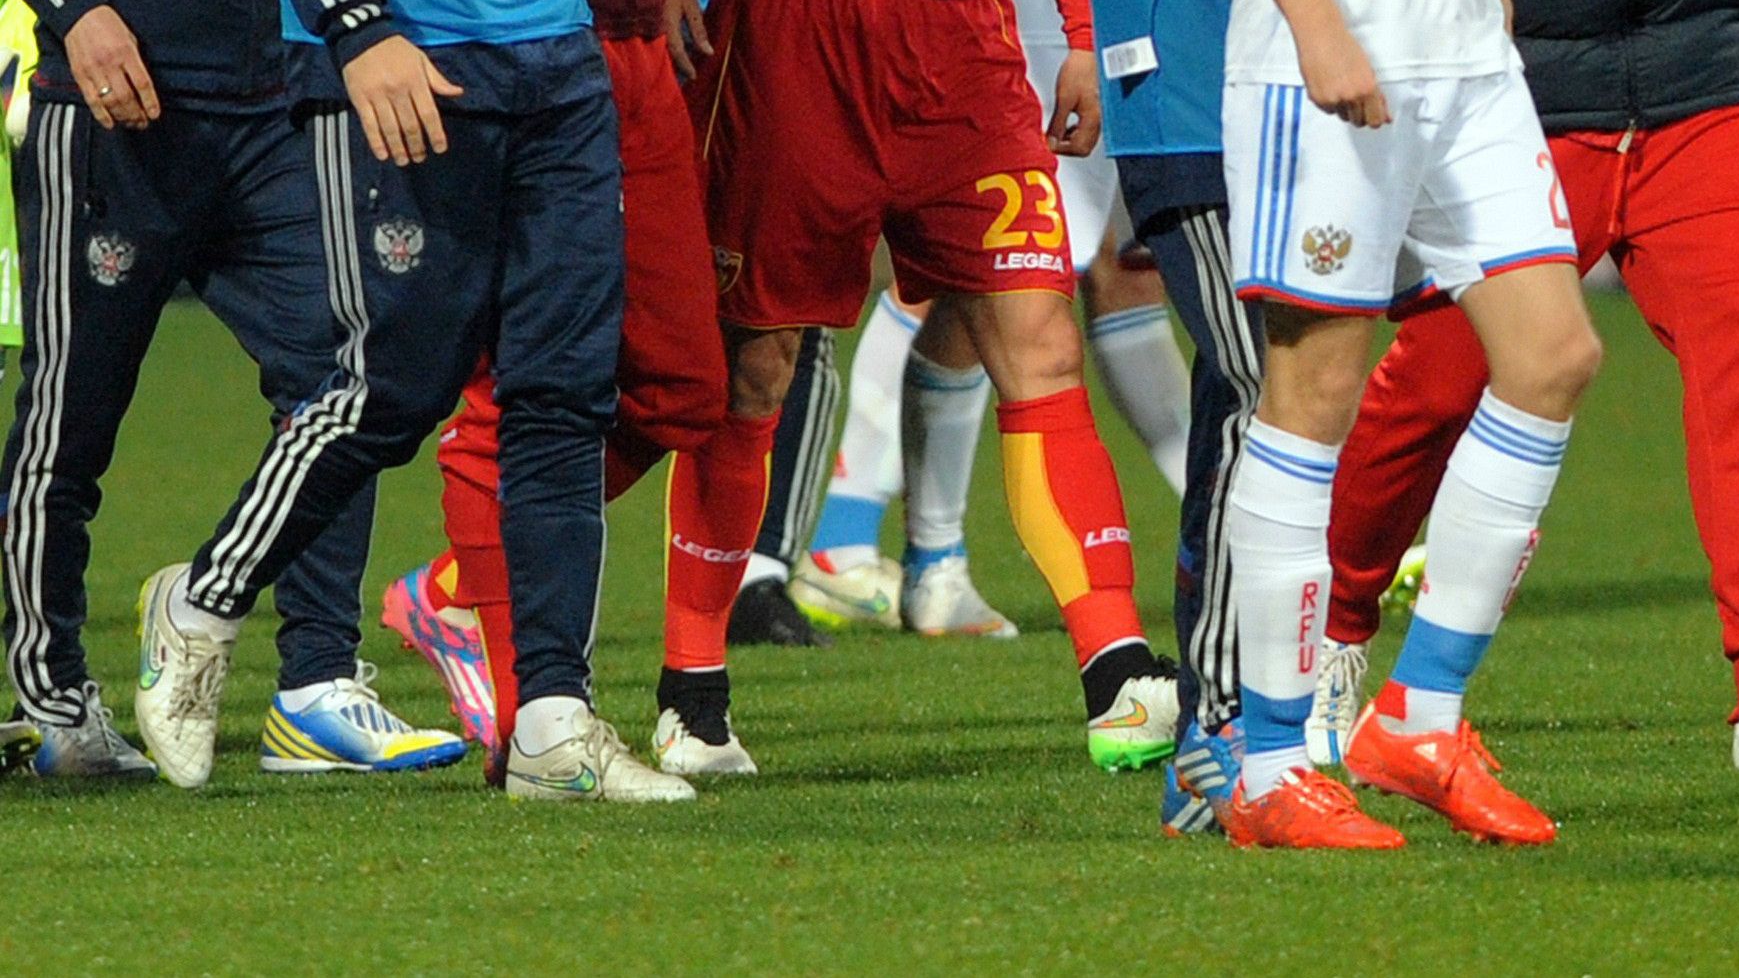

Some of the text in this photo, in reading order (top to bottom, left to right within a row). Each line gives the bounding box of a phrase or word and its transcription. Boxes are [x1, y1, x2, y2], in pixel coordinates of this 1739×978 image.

[975, 169, 1064, 250] 23
[993, 252, 1064, 273] LEGEA
[1299, 580, 1320, 675] RFU
